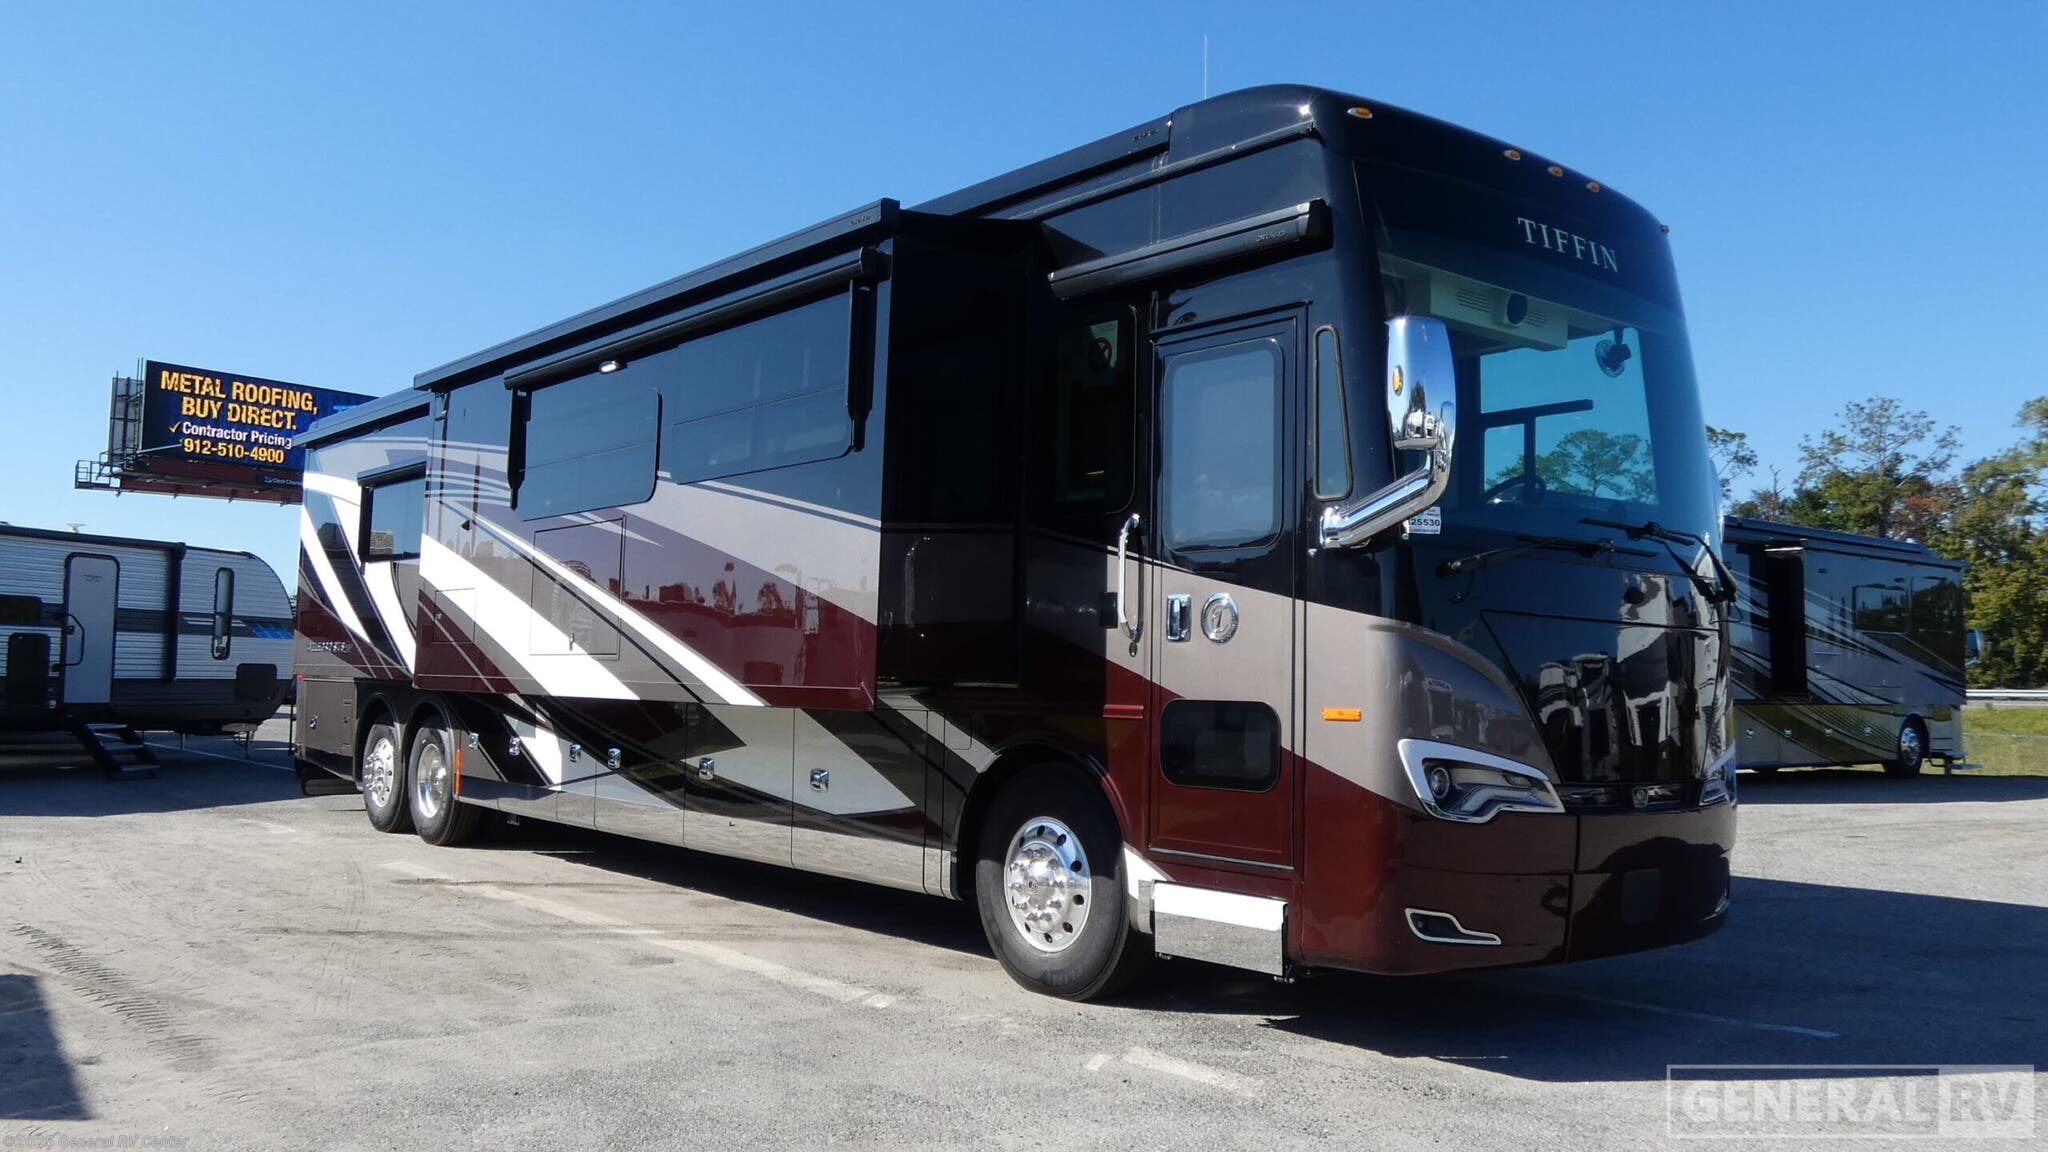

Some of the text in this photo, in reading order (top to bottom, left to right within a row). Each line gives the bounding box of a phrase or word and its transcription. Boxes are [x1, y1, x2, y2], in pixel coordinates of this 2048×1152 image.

[1517, 216, 1618, 273] TIFFIN
[160, 370, 318, 415] METAL ROOFING,
[181, 396, 297, 430] BUY DIRECT.
[182, 421, 293, 450] Contractor Pricing
[183, 437, 285, 464] 912-510-4900
[1408, 519, 1440, 527] 25530
